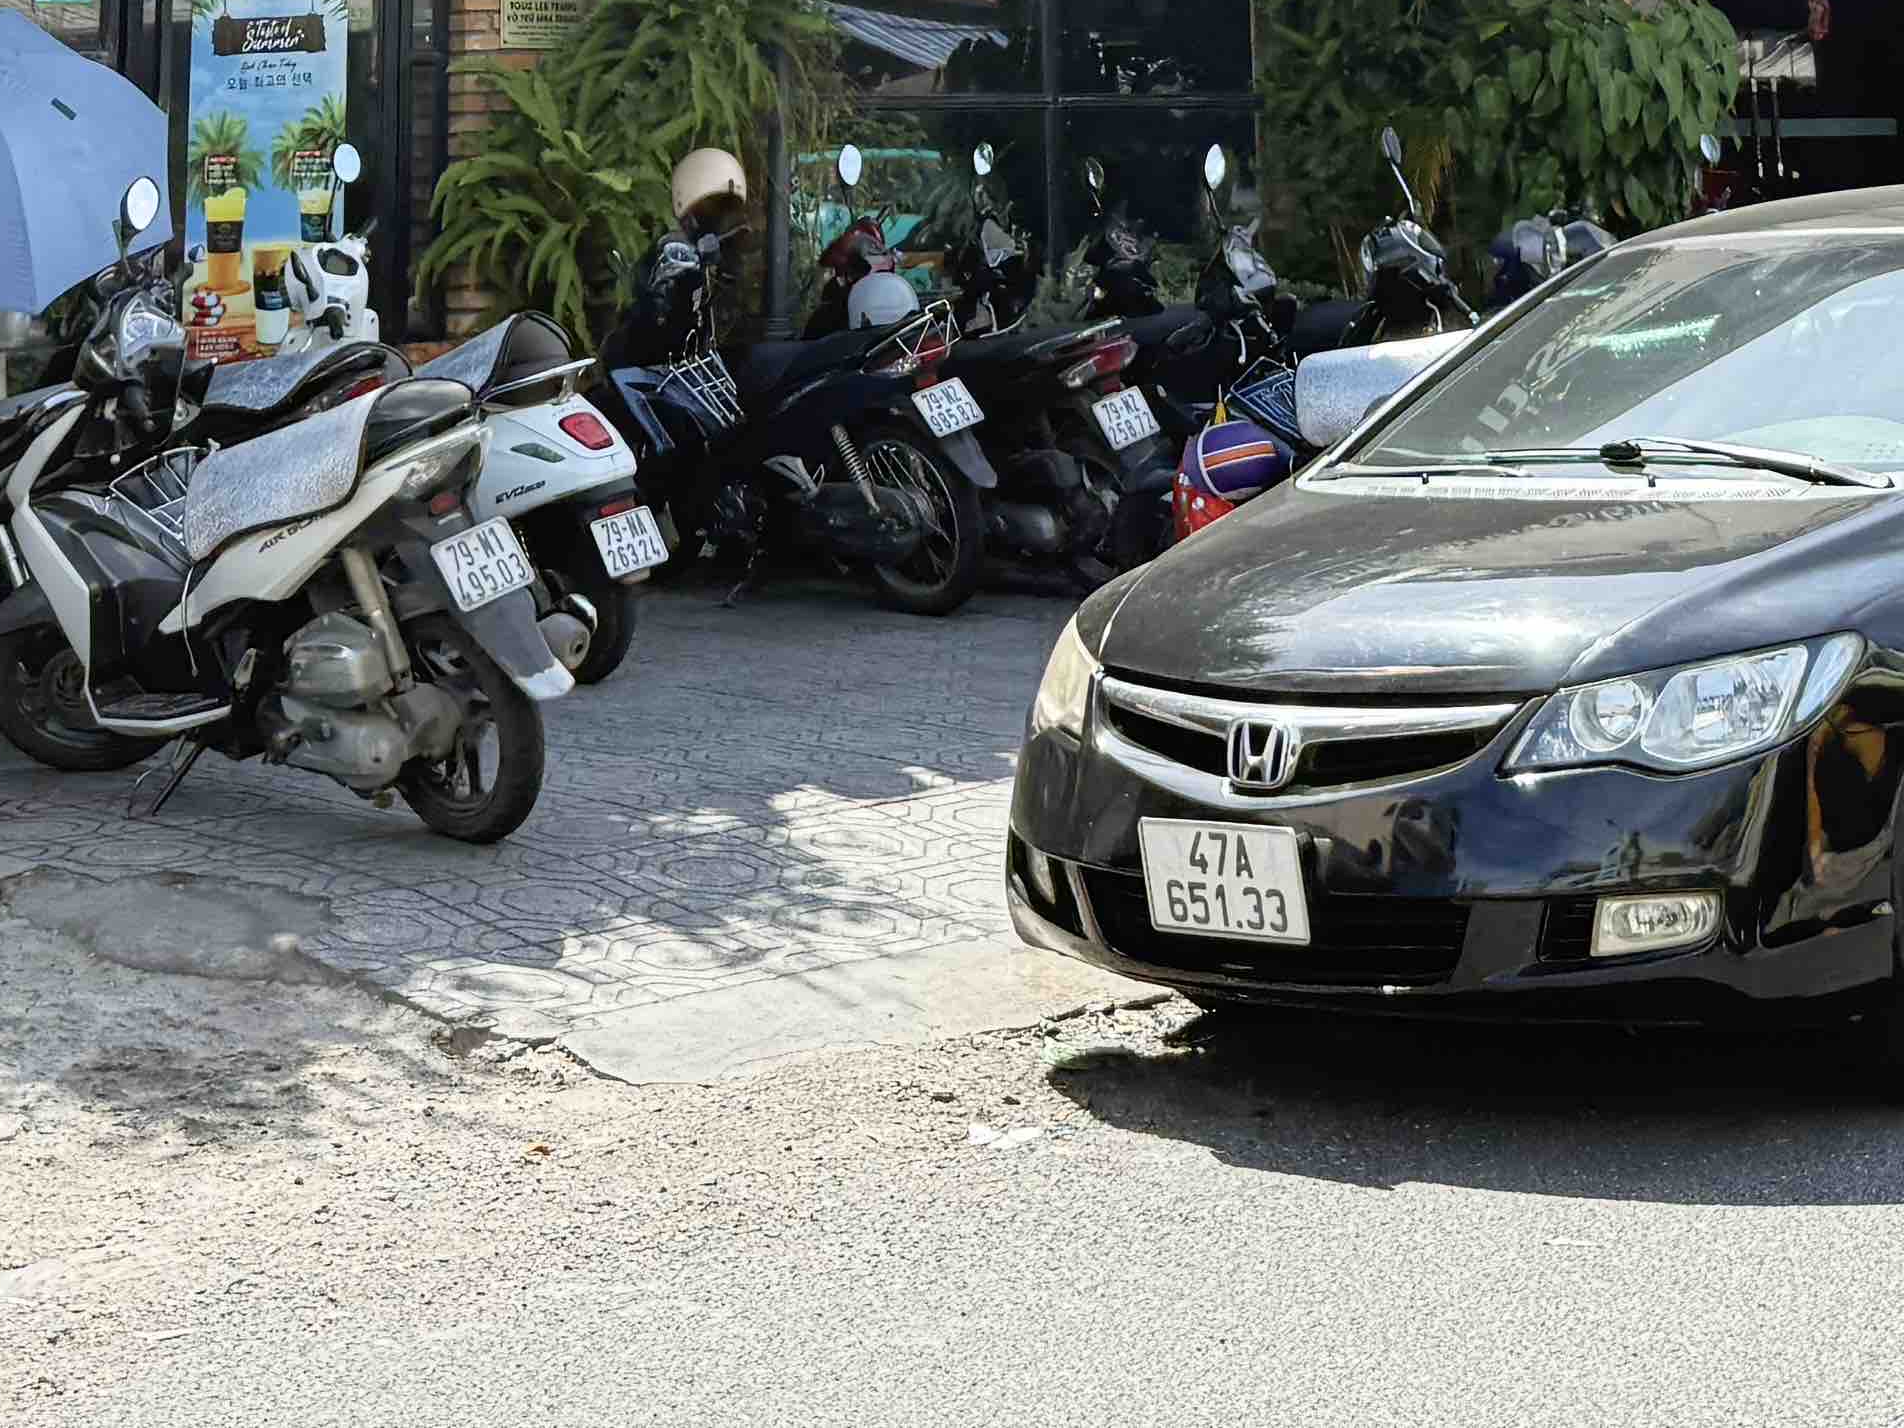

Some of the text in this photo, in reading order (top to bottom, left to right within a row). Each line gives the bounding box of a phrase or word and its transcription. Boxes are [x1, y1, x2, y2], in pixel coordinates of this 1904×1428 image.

[446, 526, 508, 572] 79-N1
[600, 515, 649, 547] 79-NA
[1188, 831, 1254, 880] 47A
[1166, 879, 1288, 933] 651.33
